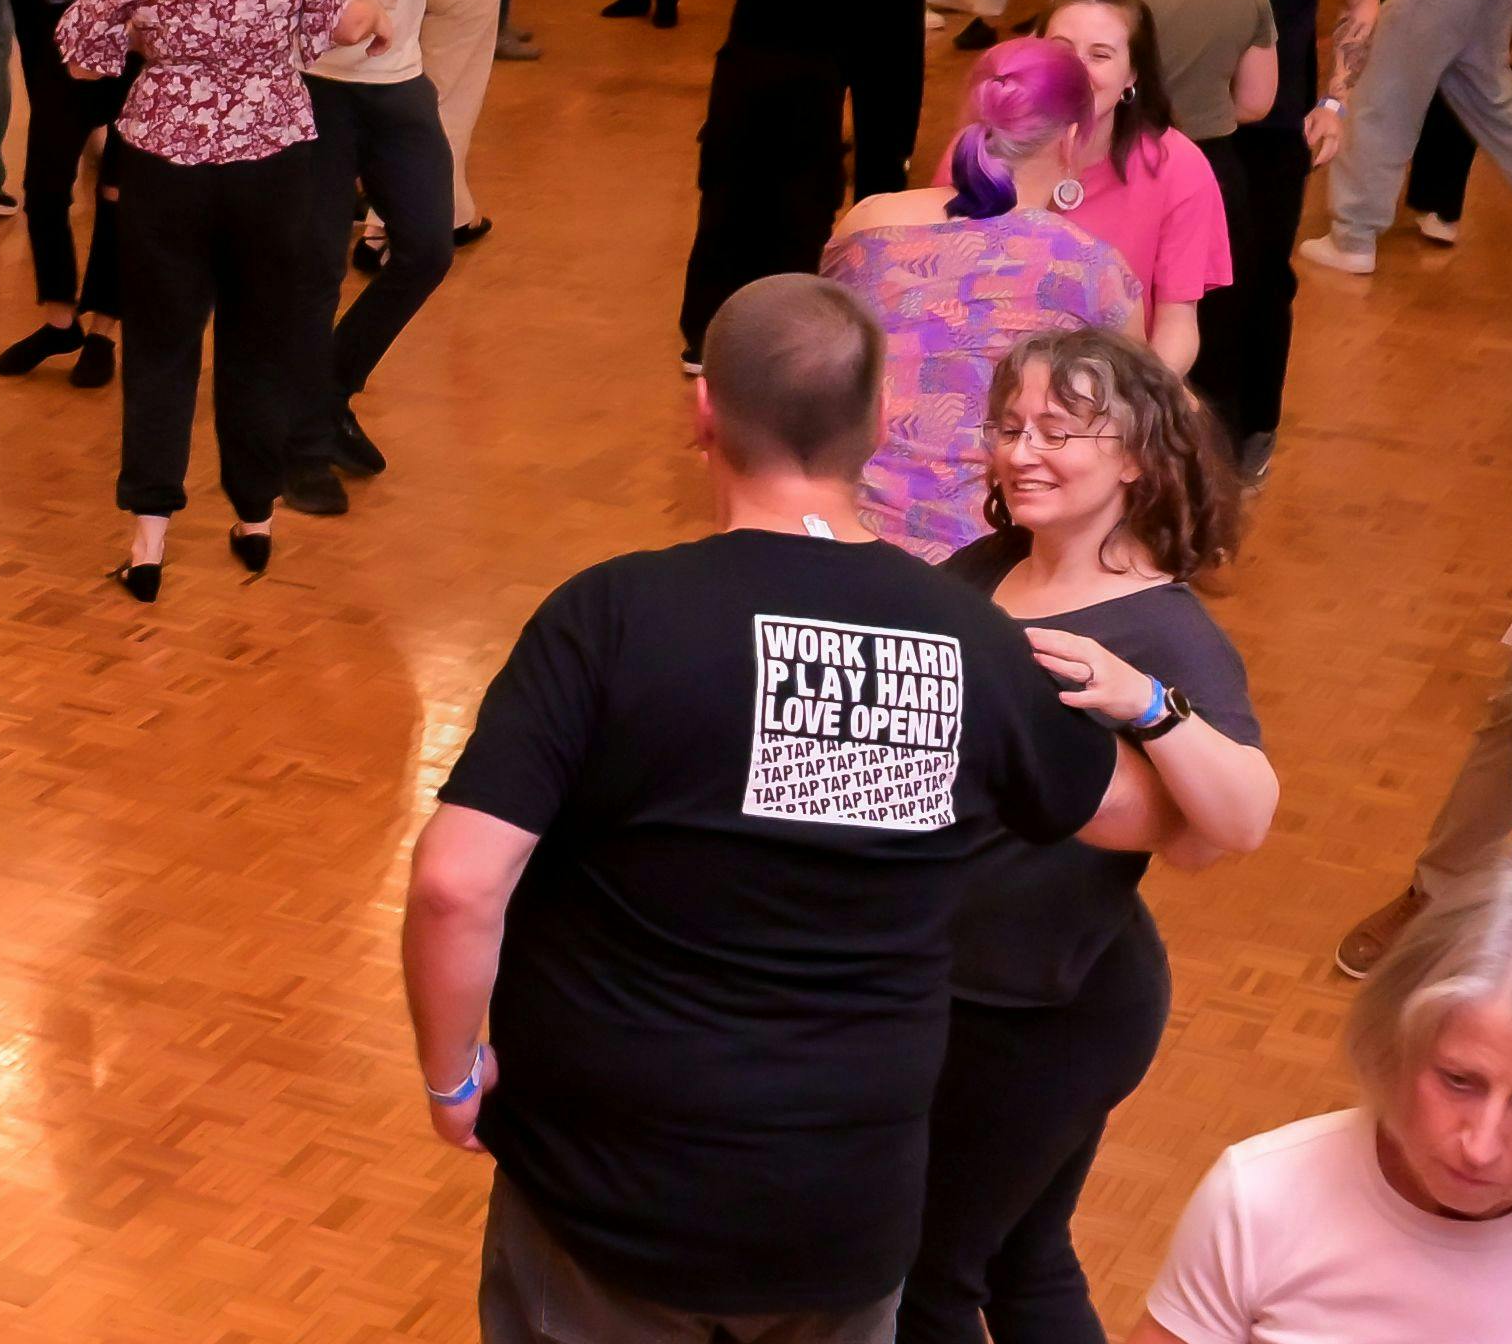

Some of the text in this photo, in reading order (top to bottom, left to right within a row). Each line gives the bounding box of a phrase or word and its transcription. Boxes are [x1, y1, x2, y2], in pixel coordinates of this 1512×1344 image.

[764, 625, 956, 677] WORK HARD
[767, 660, 956, 713] PLAY HARD
[764, 695, 956, 748] LOVE OPENLY
[761, 765, 793, 784] TAP
[795, 759, 825, 778] TAP
[827, 753, 856, 772] TAP
[859, 748, 888, 766] TAP
[785, 741, 814, 760] TAP
[753, 757, 941, 804] TAP TAP TAP TAP TAP TAP
[832, 792, 862, 811] TAP
[864, 787, 894, 805] TAP
[895, 781, 921, 799] TAP
[924, 773, 946, 793] TAP
[889, 801, 916, 820] TAP
[918, 794, 942, 813] TAP
